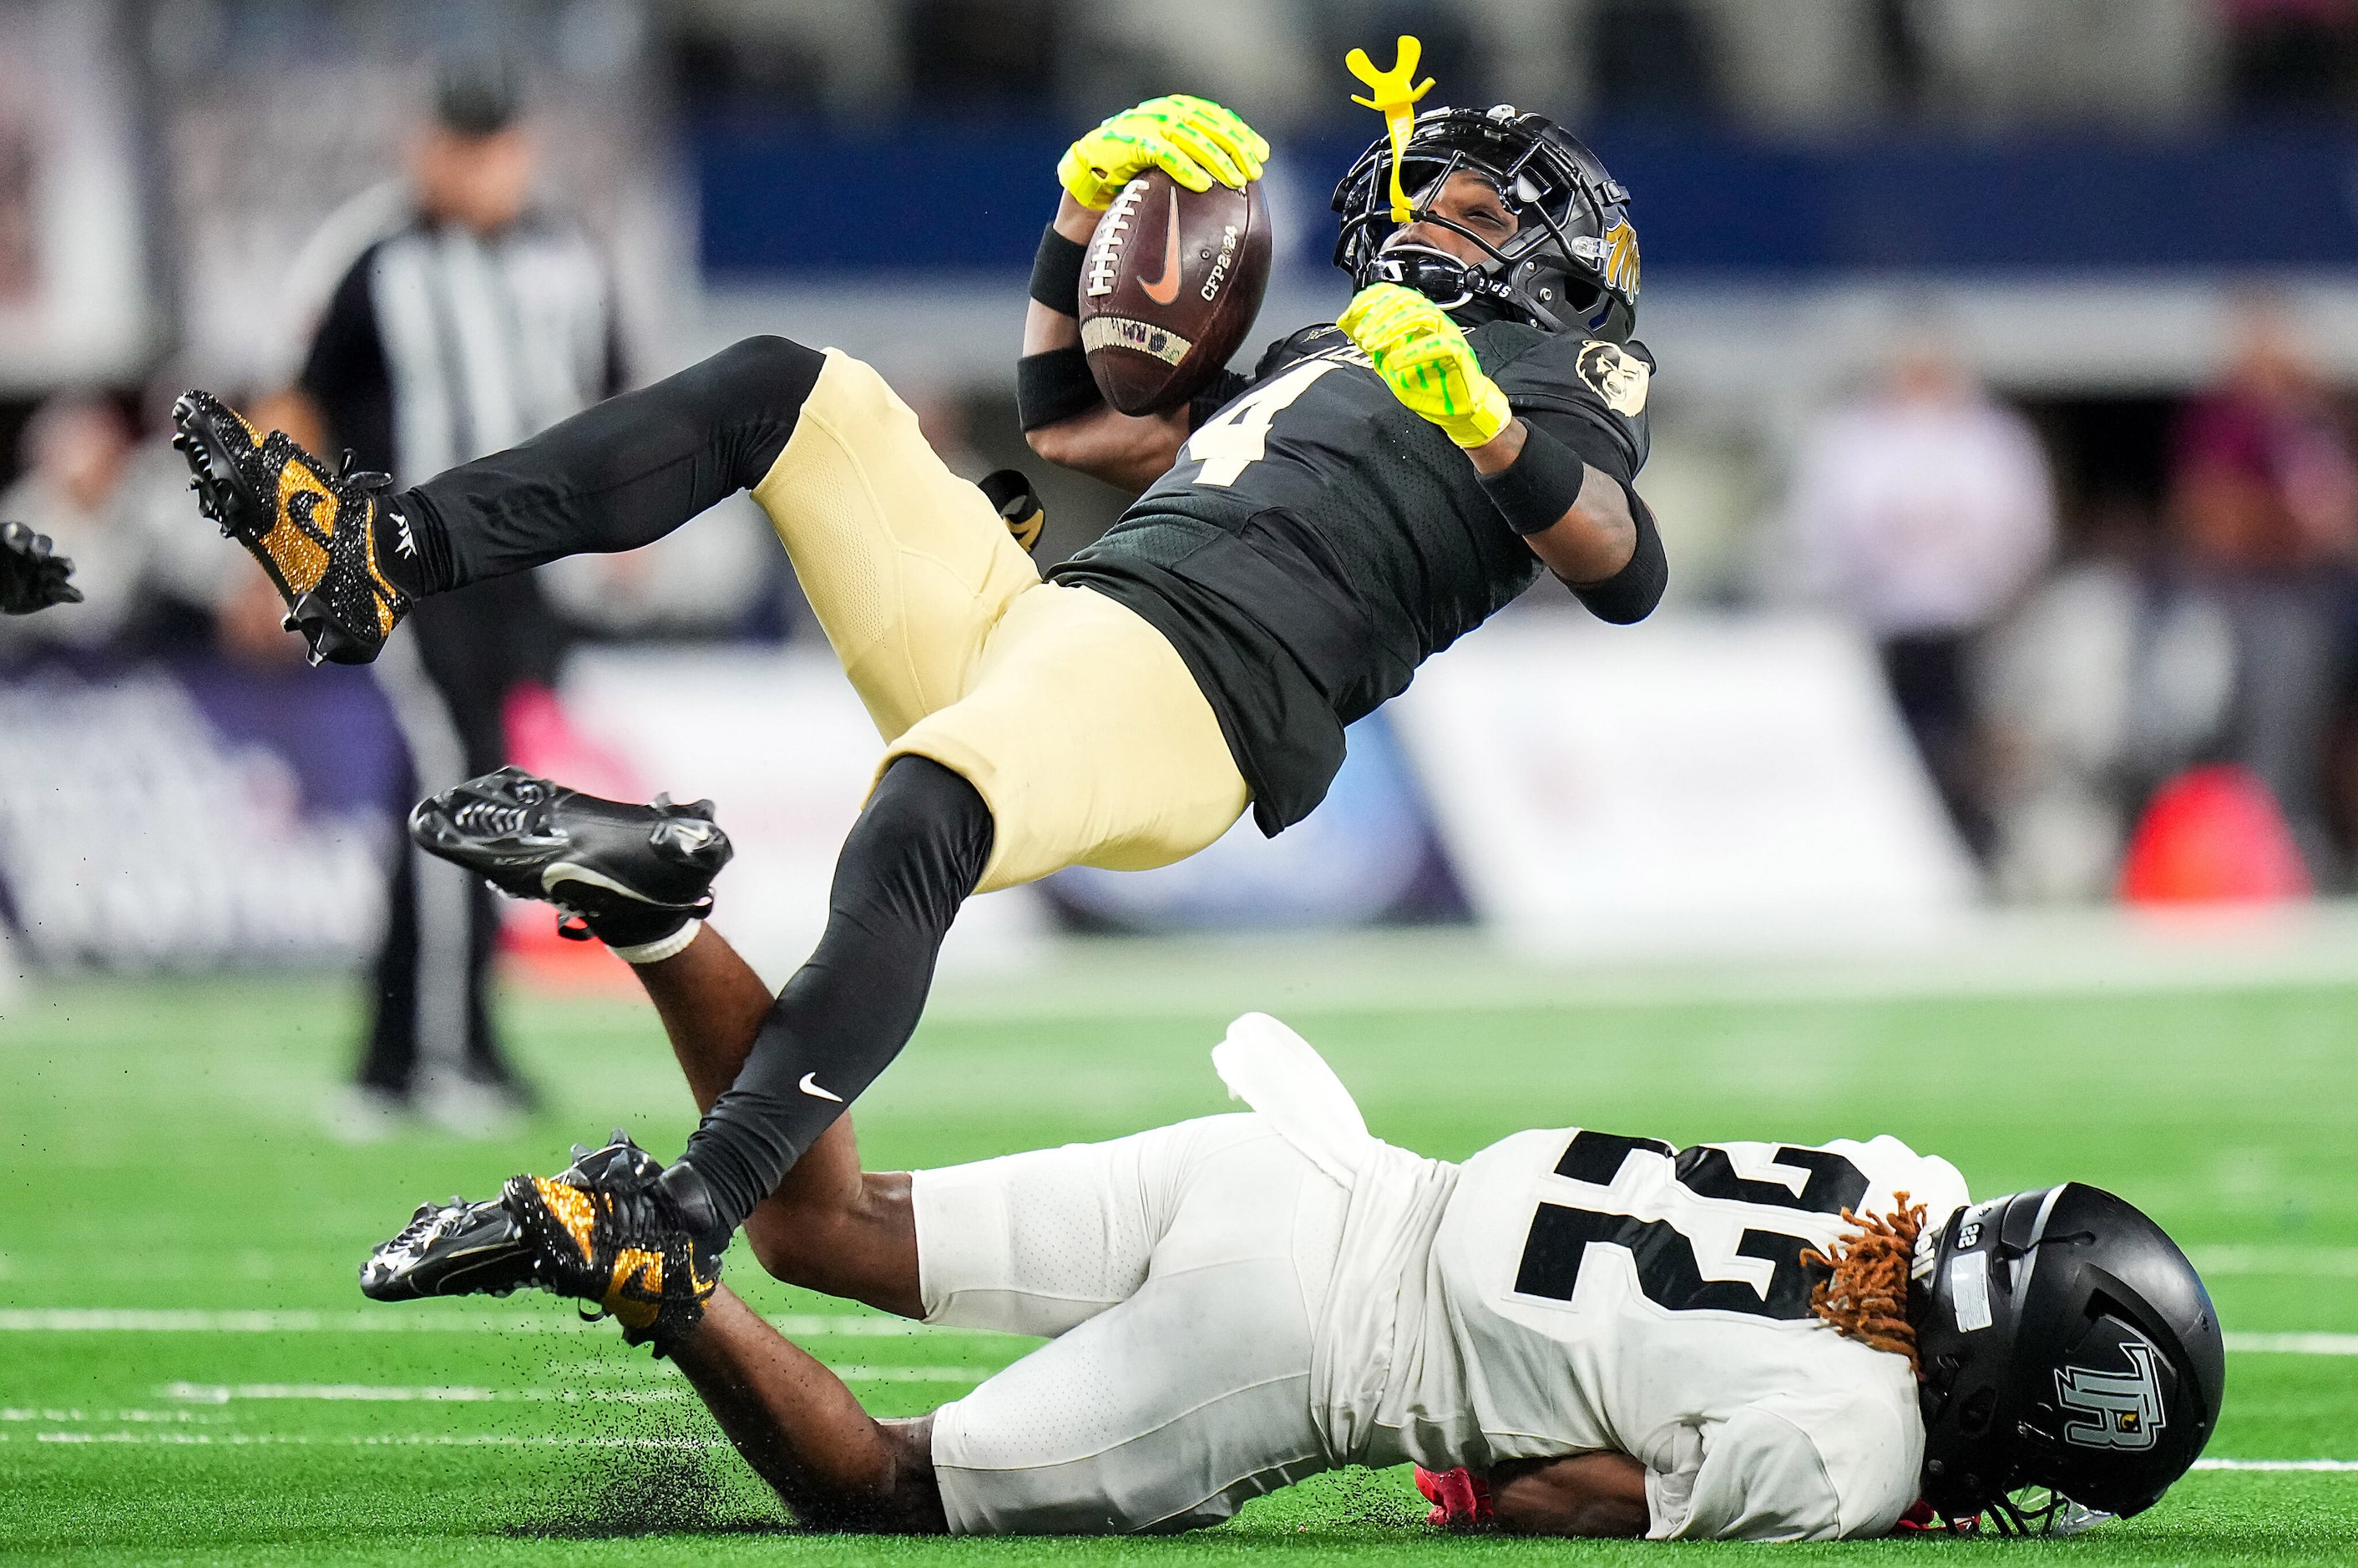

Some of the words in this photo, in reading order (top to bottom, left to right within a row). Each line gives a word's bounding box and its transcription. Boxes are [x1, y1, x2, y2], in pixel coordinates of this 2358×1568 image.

[1201, 225, 1237, 301] CFP2024
[1188, 359, 1344, 487] 4
[1514, 1130, 1870, 1319] 22
[1958, 1223, 1980, 1249] 22
